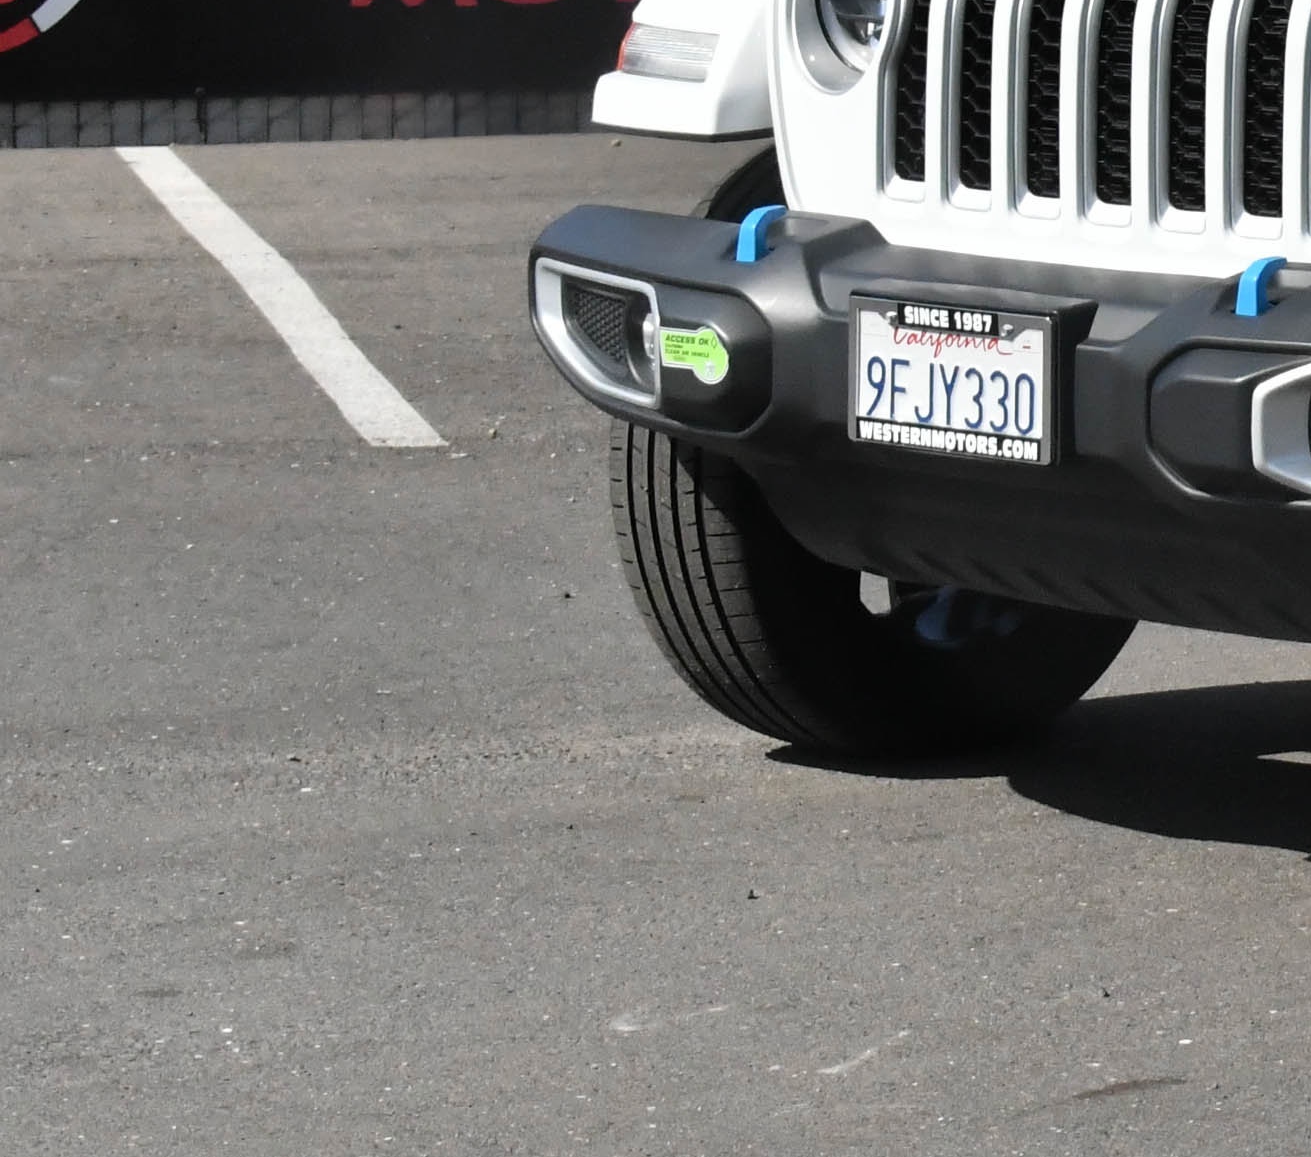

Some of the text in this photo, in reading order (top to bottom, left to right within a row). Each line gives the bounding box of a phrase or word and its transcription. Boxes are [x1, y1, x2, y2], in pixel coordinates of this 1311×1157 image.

[904, 306, 993, 333] SINCE 1987
[665, 333, 709, 346] ACCESS OK
[893, 326, 1013, 358] California
[866, 356, 1035, 435] 9FJY330
[859, 420, 1038, 461] WESTERNMOTORS.COM
